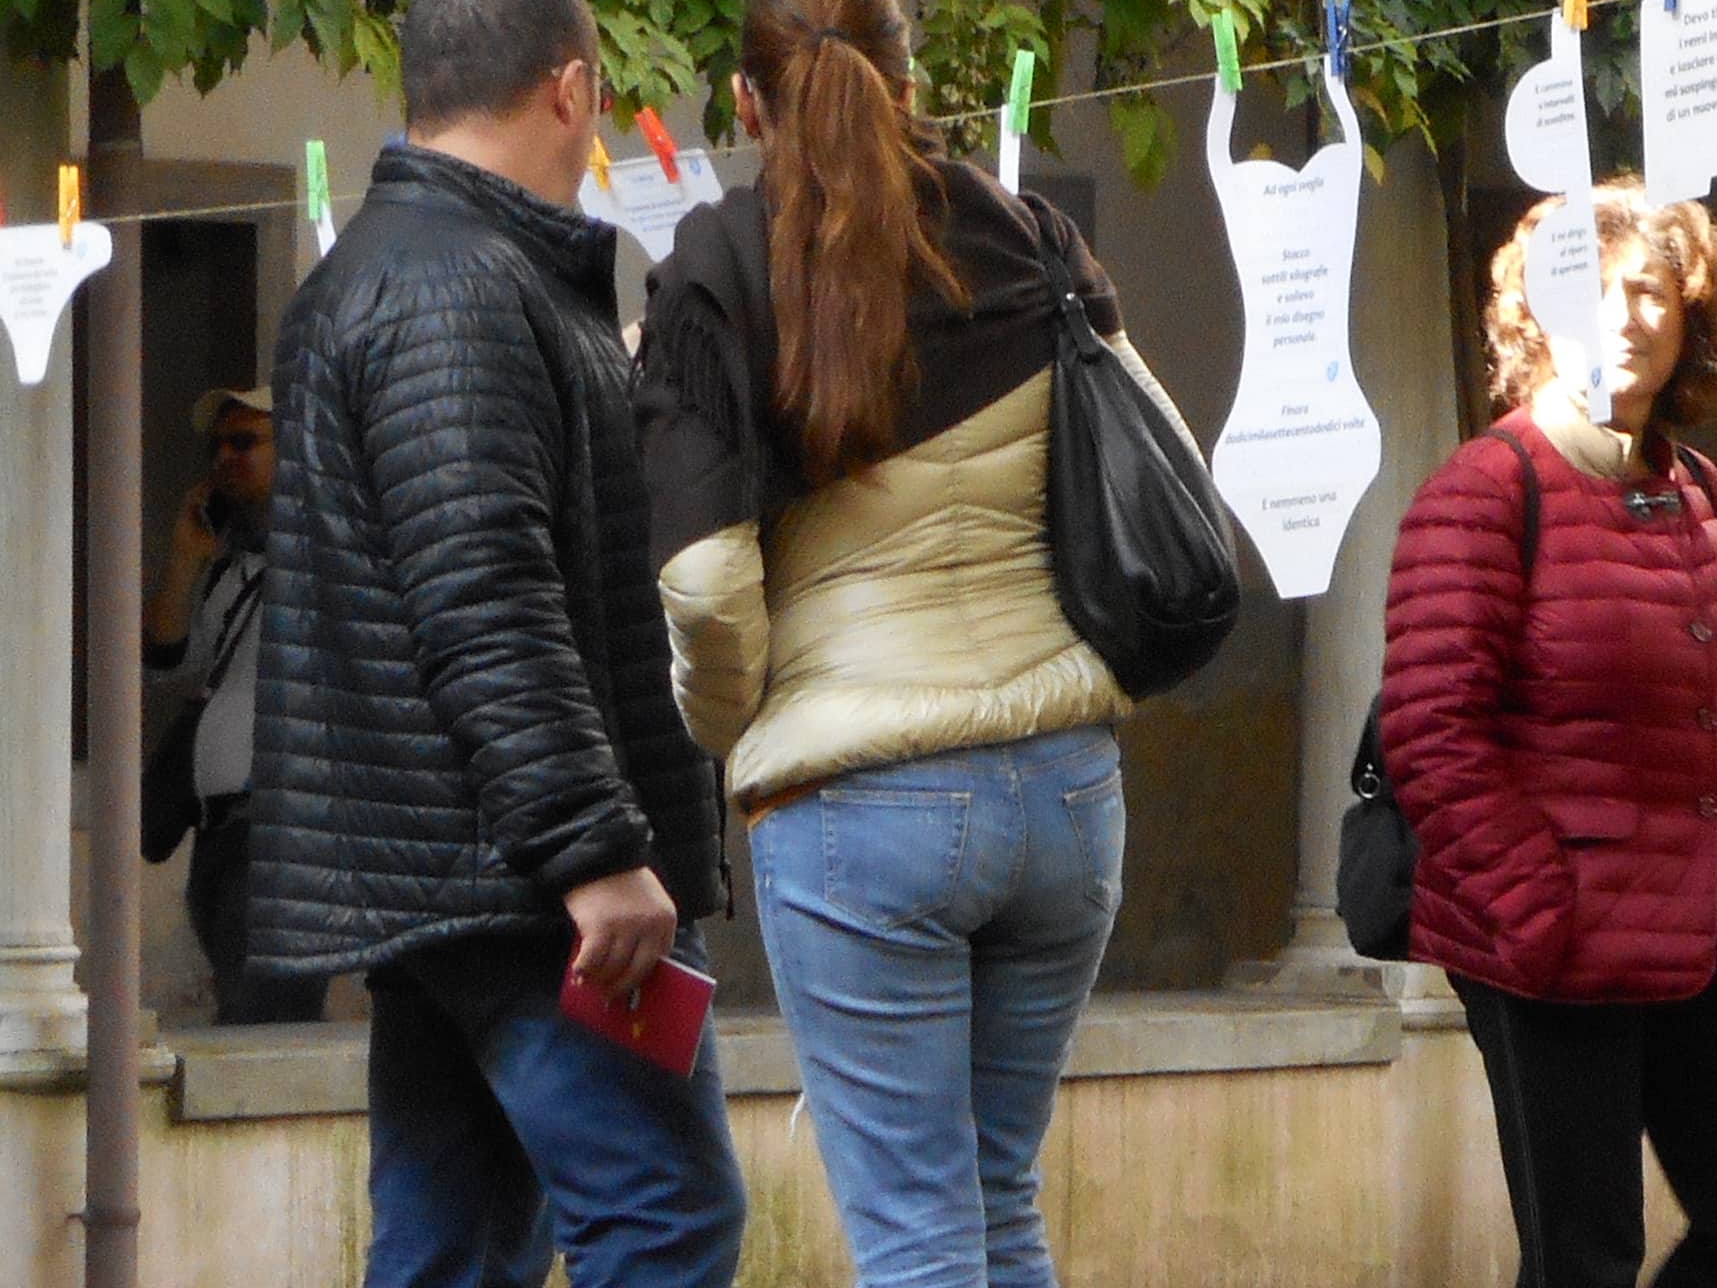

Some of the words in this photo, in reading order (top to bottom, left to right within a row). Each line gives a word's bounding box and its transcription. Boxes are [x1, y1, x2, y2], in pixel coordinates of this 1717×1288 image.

[1684, 11, 1709, 26] Devo
[1678, 38, 1683, 50] i
[1684, 31, 1707, 48] remi
[1669, 65, 1676, 76] e
[1677, 55, 1715, 73] lasciare
[1664, 84, 1678, 99] mi
[1666, 108, 1676, 122] di
[1678, 107, 1691, 119] un
